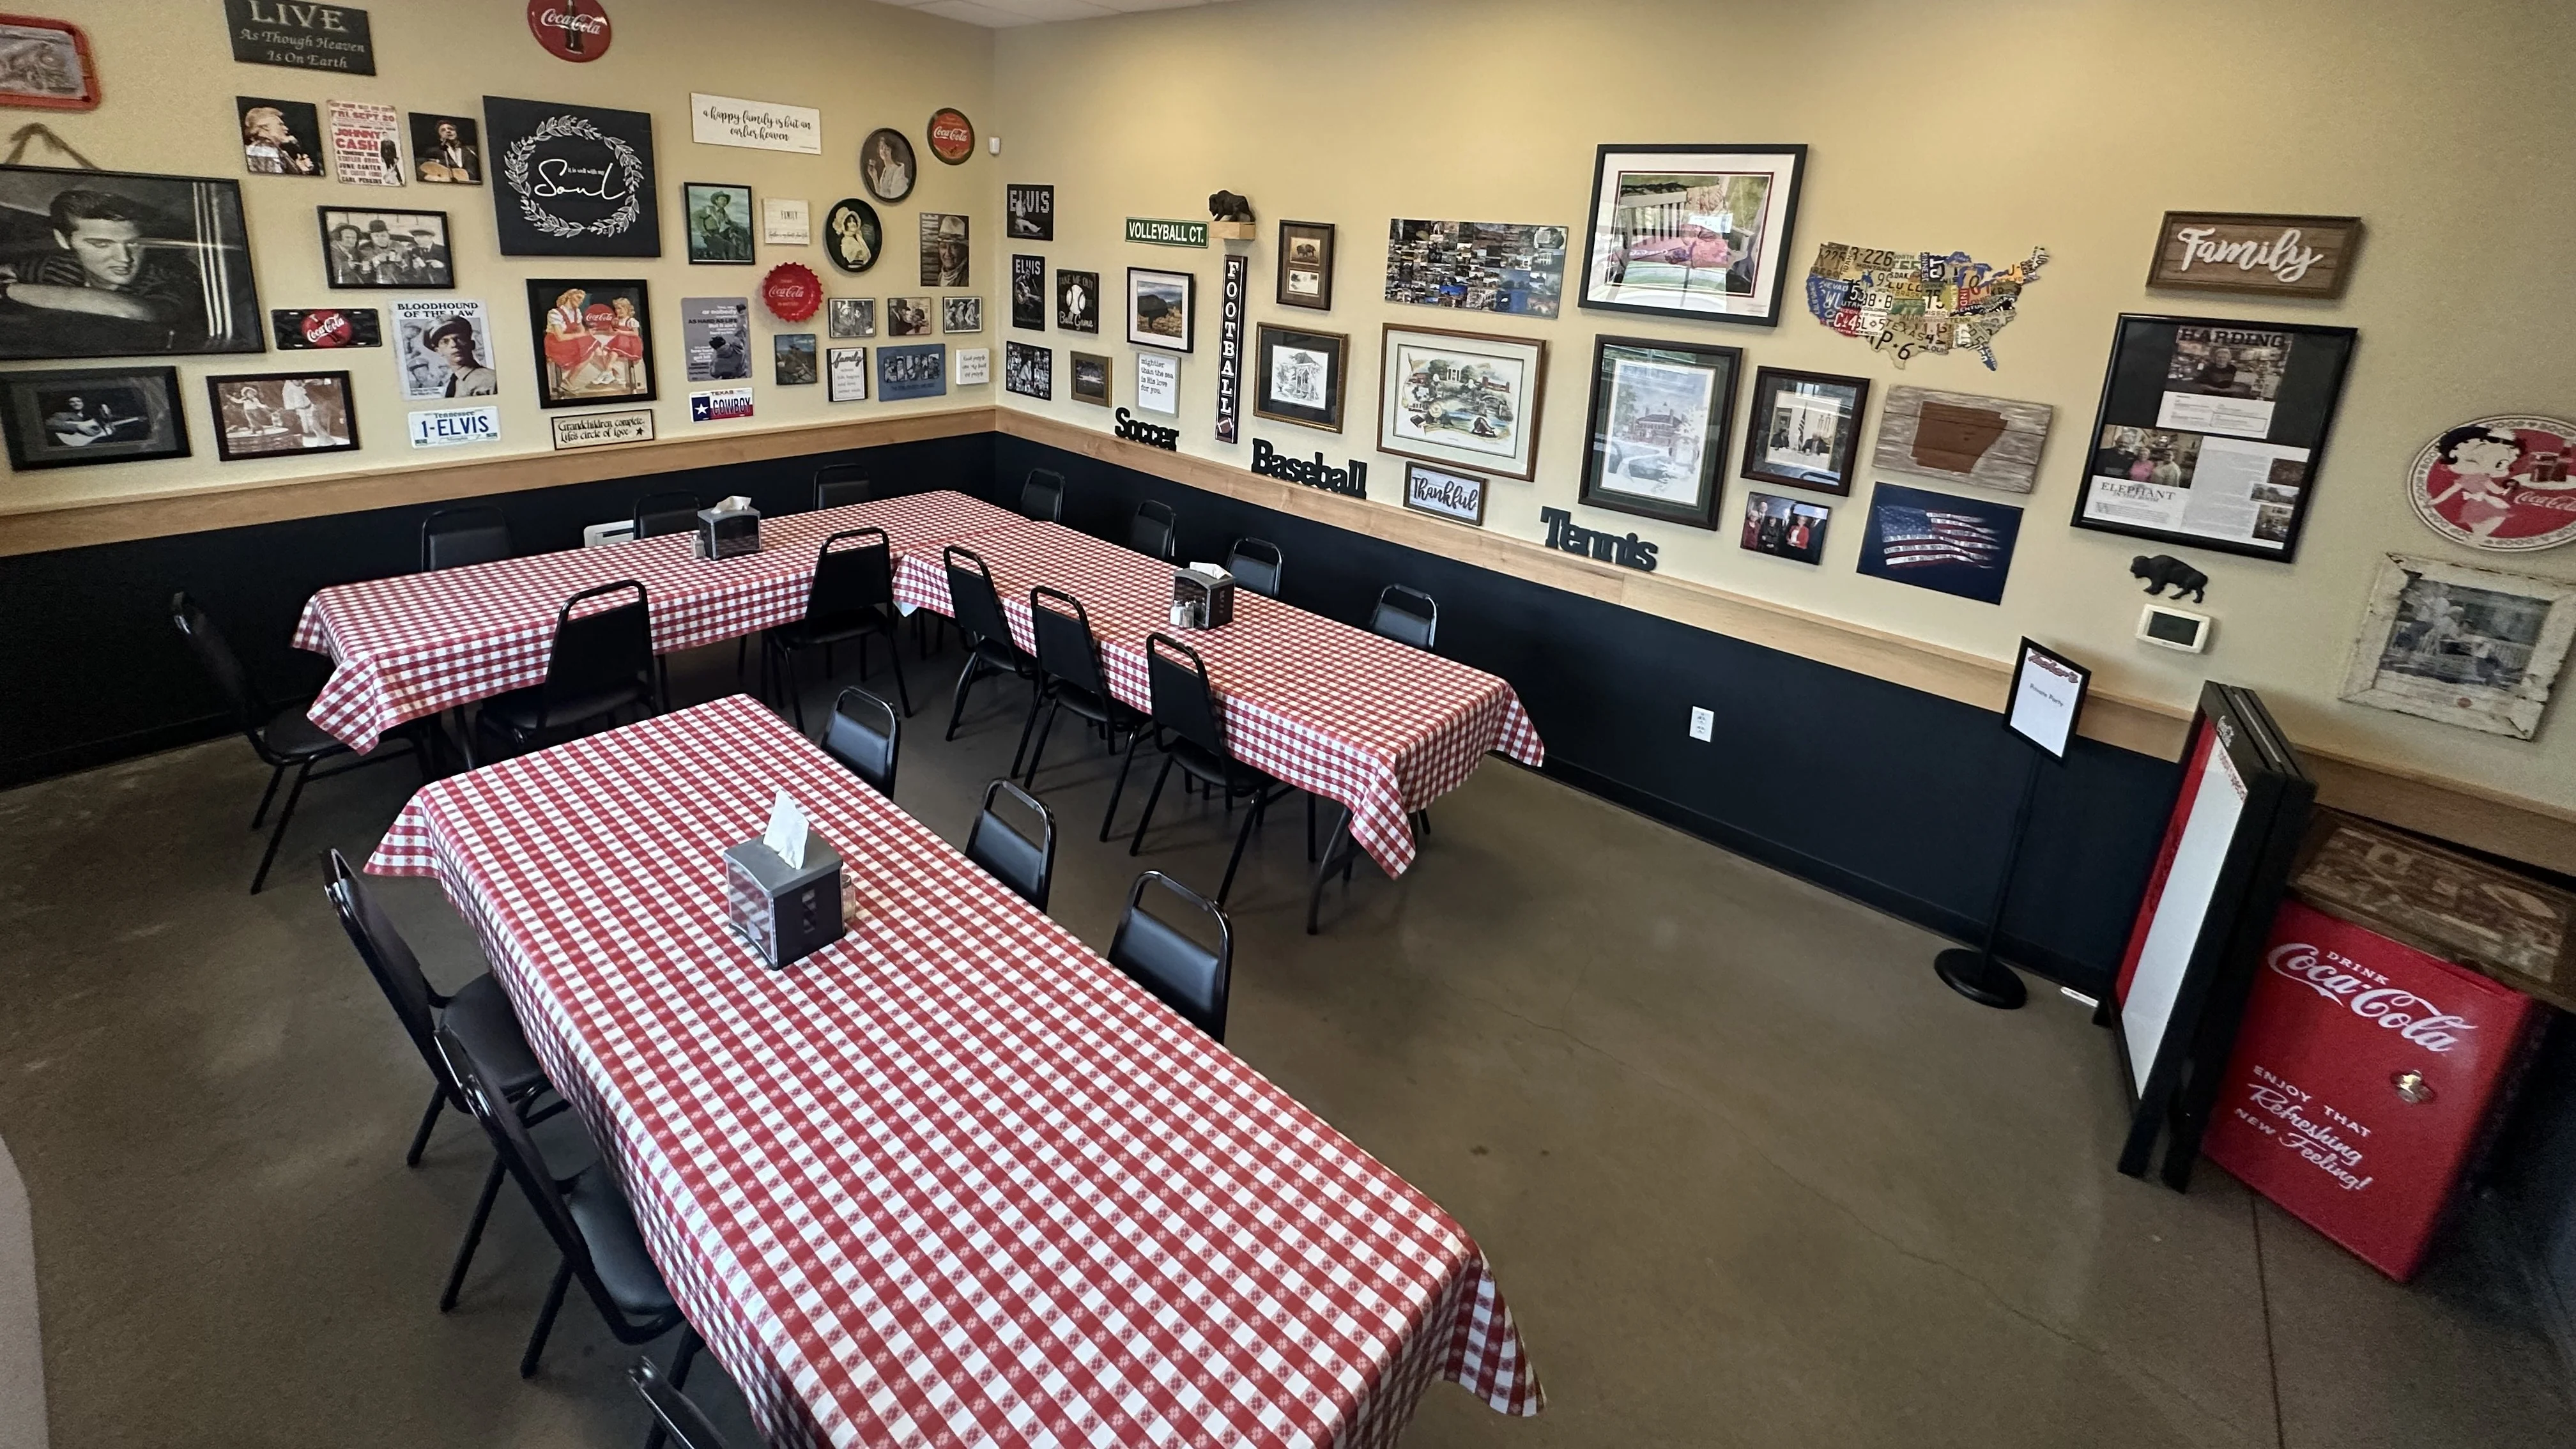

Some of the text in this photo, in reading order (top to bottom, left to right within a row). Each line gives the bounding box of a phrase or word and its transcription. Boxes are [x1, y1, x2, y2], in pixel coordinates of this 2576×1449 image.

[249, 0, 349, 32] LIVE
[240, 29, 365, 53] As Though Heaven
[267, 50, 348, 68] Is On Earth
[710, 106, 740, 125] happy
[742, 110, 774, 128] family
[775, 119, 783, 128] is
[784, 116, 799, 128] but
[801, 121, 812, 130] an
[335, 128, 381, 139] JOHNNY
[335, 138, 379, 151] CASH
[730, 125, 790, 141] earlier heaven
[1129, 222, 1204, 243] VOLLEYBALL CT.
[2177, 227, 2324, 282] Family
[1220, 261, 1239, 414] FOOTBALL
[1885, 318, 1924, 341] TEXAS
[2179, 328, 2286, 348] HARDING
[831, 351, 863, 369] family
[1141, 358, 1165, 368] mightier
[1141, 367, 1154, 376] than
[434, 410, 475, 418] Tennessee
[713, 397, 751, 415] COWBOY
[421, 415, 489, 437] 1-ELVIS
[558, 418, 613, 431] Grandchildren
[580, 429, 601, 440] circle
[603, 427, 612, 437] of
[1114, 407, 1179, 452] Soccer
[1251, 438, 1367, 500] Baseball
[1412, 477, 1478, 511] Thankful
[2101, 482, 2176, 500] ELEPHANT
[1540, 505, 1659, 572] Tennis
[2030, 682, 2064, 707] Private Party
[2326, 951, 2389, 985] DRINK
[2268, 942, 2479, 1052] Coca-Cola
[2253, 1065, 2372, 1137] ENJOY THAT
[2247, 1082, 2363, 1166] Refreshing
[2234, 1107, 2374, 1190] NEW Feeling!
